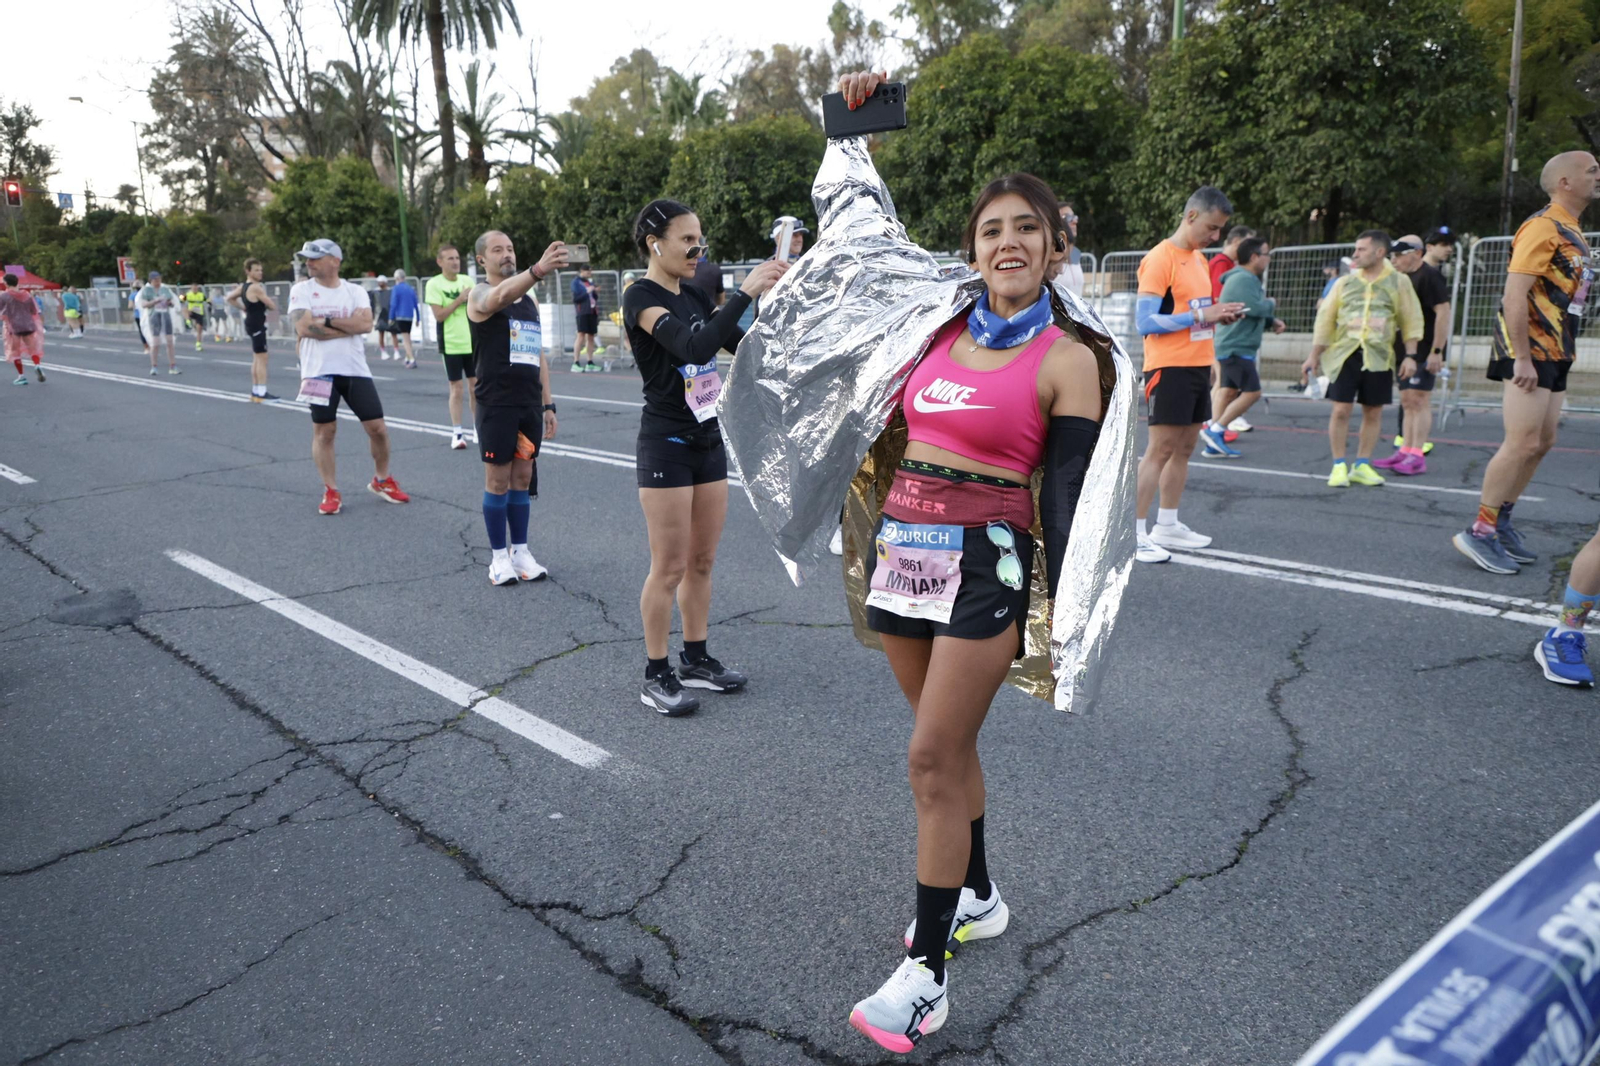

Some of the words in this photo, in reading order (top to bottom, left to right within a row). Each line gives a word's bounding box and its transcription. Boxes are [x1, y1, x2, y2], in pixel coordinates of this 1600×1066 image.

[924, 378, 977, 405] NIKE
[888, 490, 946, 515] HANKER
[897, 530, 949, 544] ZURICH
[898, 558, 922, 572] 9861
